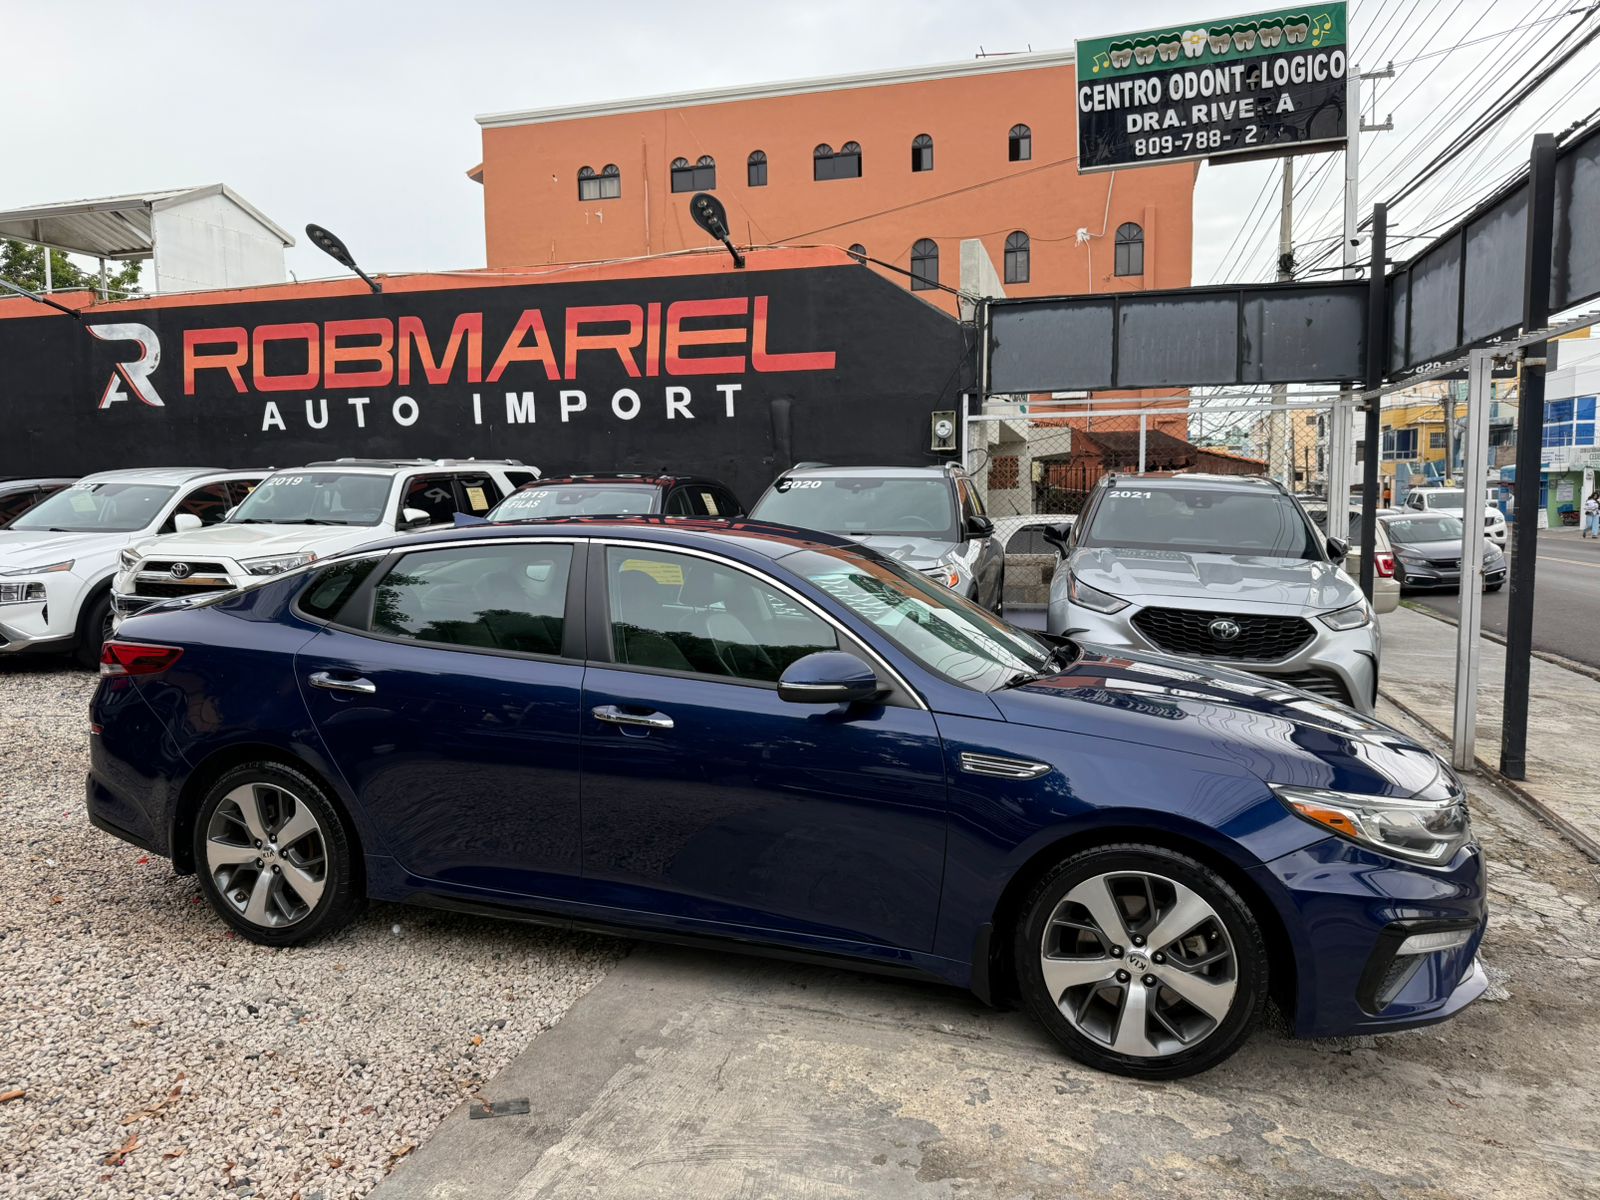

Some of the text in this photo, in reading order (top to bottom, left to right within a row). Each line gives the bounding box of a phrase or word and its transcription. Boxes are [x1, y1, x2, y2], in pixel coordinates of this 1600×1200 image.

[1079, 50, 1346, 112] CENTRO ODONTLOGICO
[1127, 92, 1295, 134] DRA. RIVEA
[183, 295, 836, 396] ROBMARIEL
[261, 383, 742, 432] AUTO IMPORT
[267, 477, 303, 487] 2019
[779, 480, 822, 489] 2020
[1109, 490, 1152, 499] 2021
[263, 850, 275, 858] KIA
[1129, 955, 1147, 970] KIA
